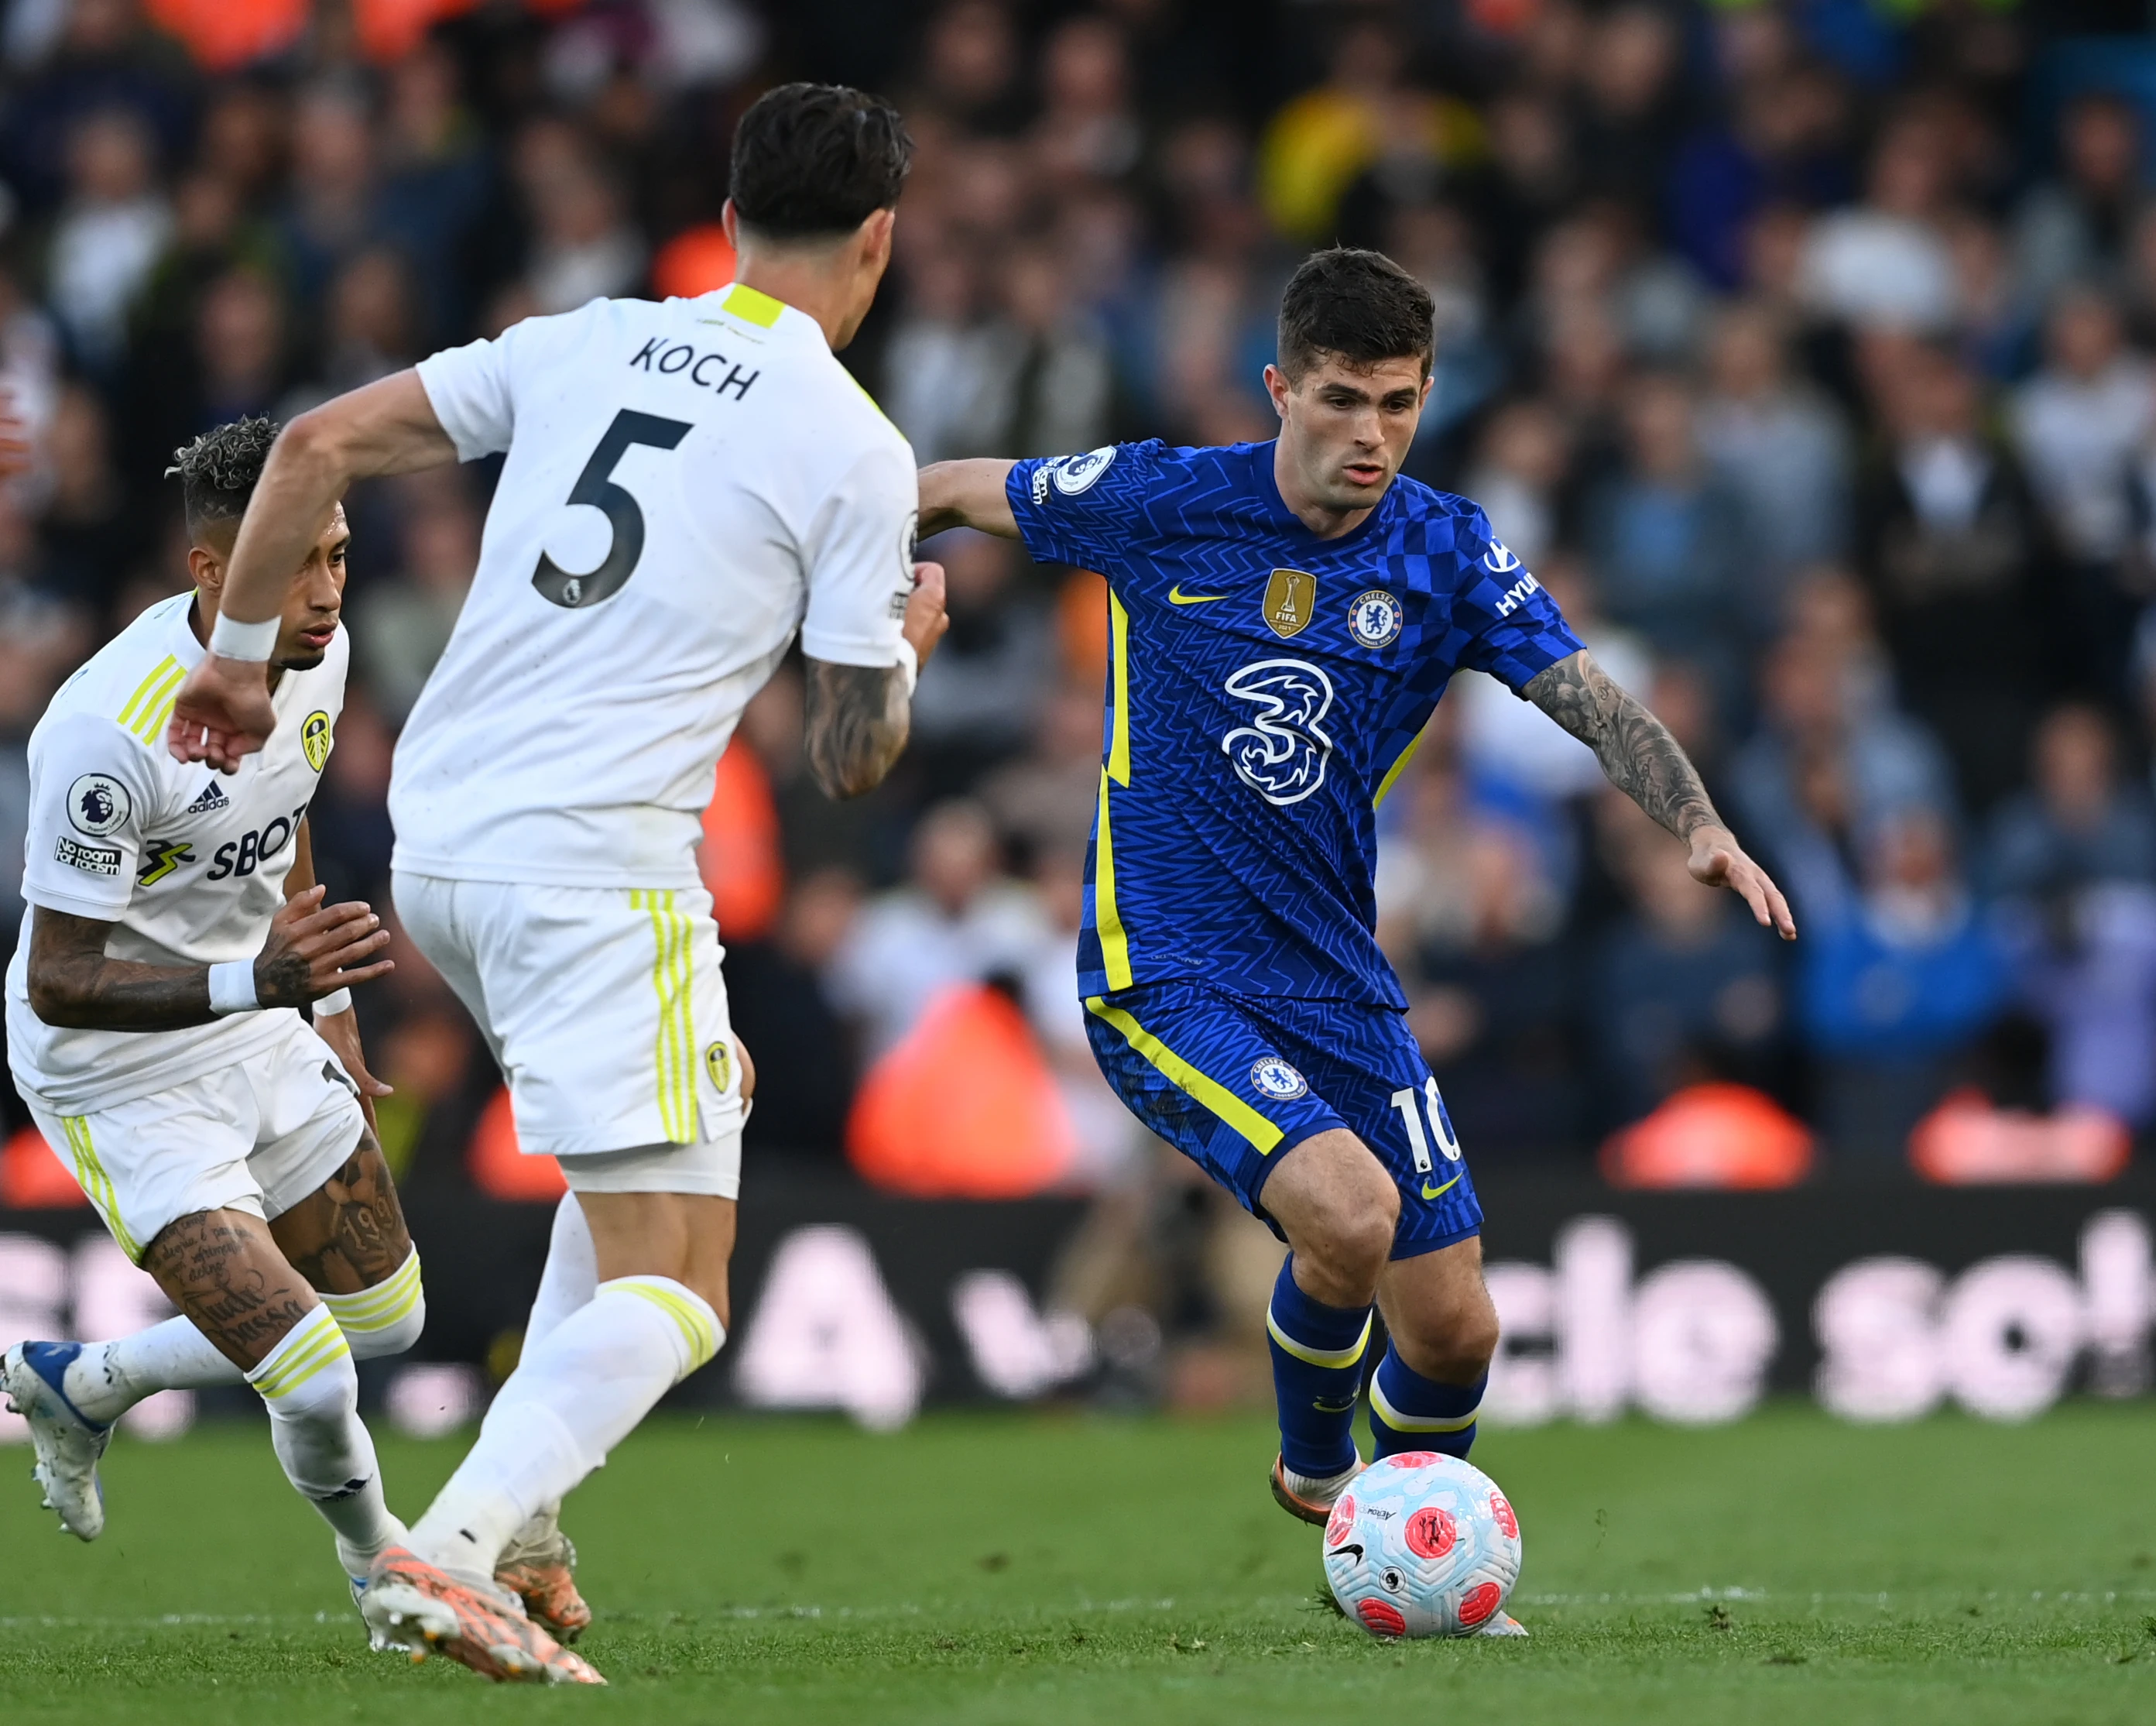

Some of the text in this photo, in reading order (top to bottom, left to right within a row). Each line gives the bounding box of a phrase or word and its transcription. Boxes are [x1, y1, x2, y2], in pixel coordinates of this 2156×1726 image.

[629, 336, 761, 401] KOCH
[531, 408, 696, 609] 5
[1359, 593, 1393, 606] CHELSEA
[1275, 611, 1297, 623] FIFA
[187, 796, 230, 814] adidas
[109, 810, 122, 828] League
[57, 836, 115, 863] No room
[207, 801, 308, 880] SBOT
[54, 848, 120, 875] for racism
[1390, 1076, 1462, 1174] 10
